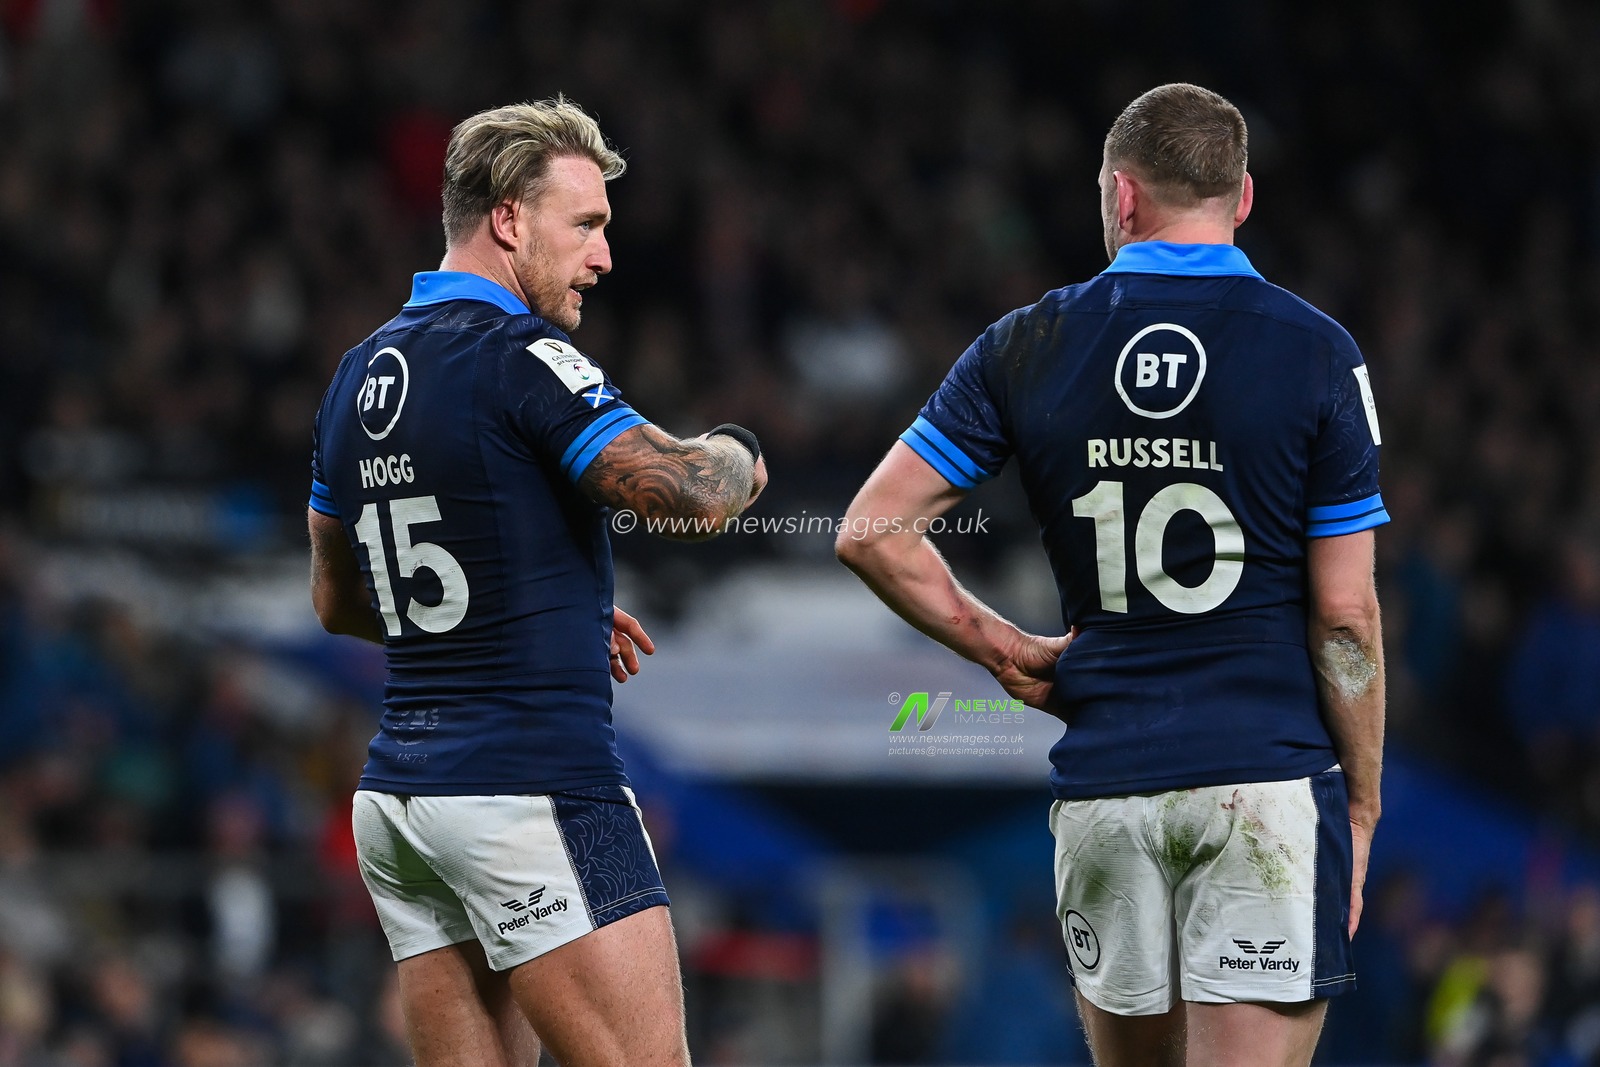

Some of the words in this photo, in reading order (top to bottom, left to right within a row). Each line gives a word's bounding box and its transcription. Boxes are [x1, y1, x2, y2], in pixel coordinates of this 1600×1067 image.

[1136, 353, 1187, 388] BT
[363, 376, 395, 412] BT
[359, 453, 415, 489] HOGG
[1087, 437, 1224, 472] RUSSELL
[1072, 480, 1245, 614] 10
[354, 495, 469, 636] 15
[395, 752, 428, 764] 1873
[497, 914, 530, 936] Peter
[529, 898, 568, 921] Vardy
[1071, 925, 1091, 952] BT
[1219, 956, 1257, 970] Peter
[1258, 957, 1300, 973] Vardy
